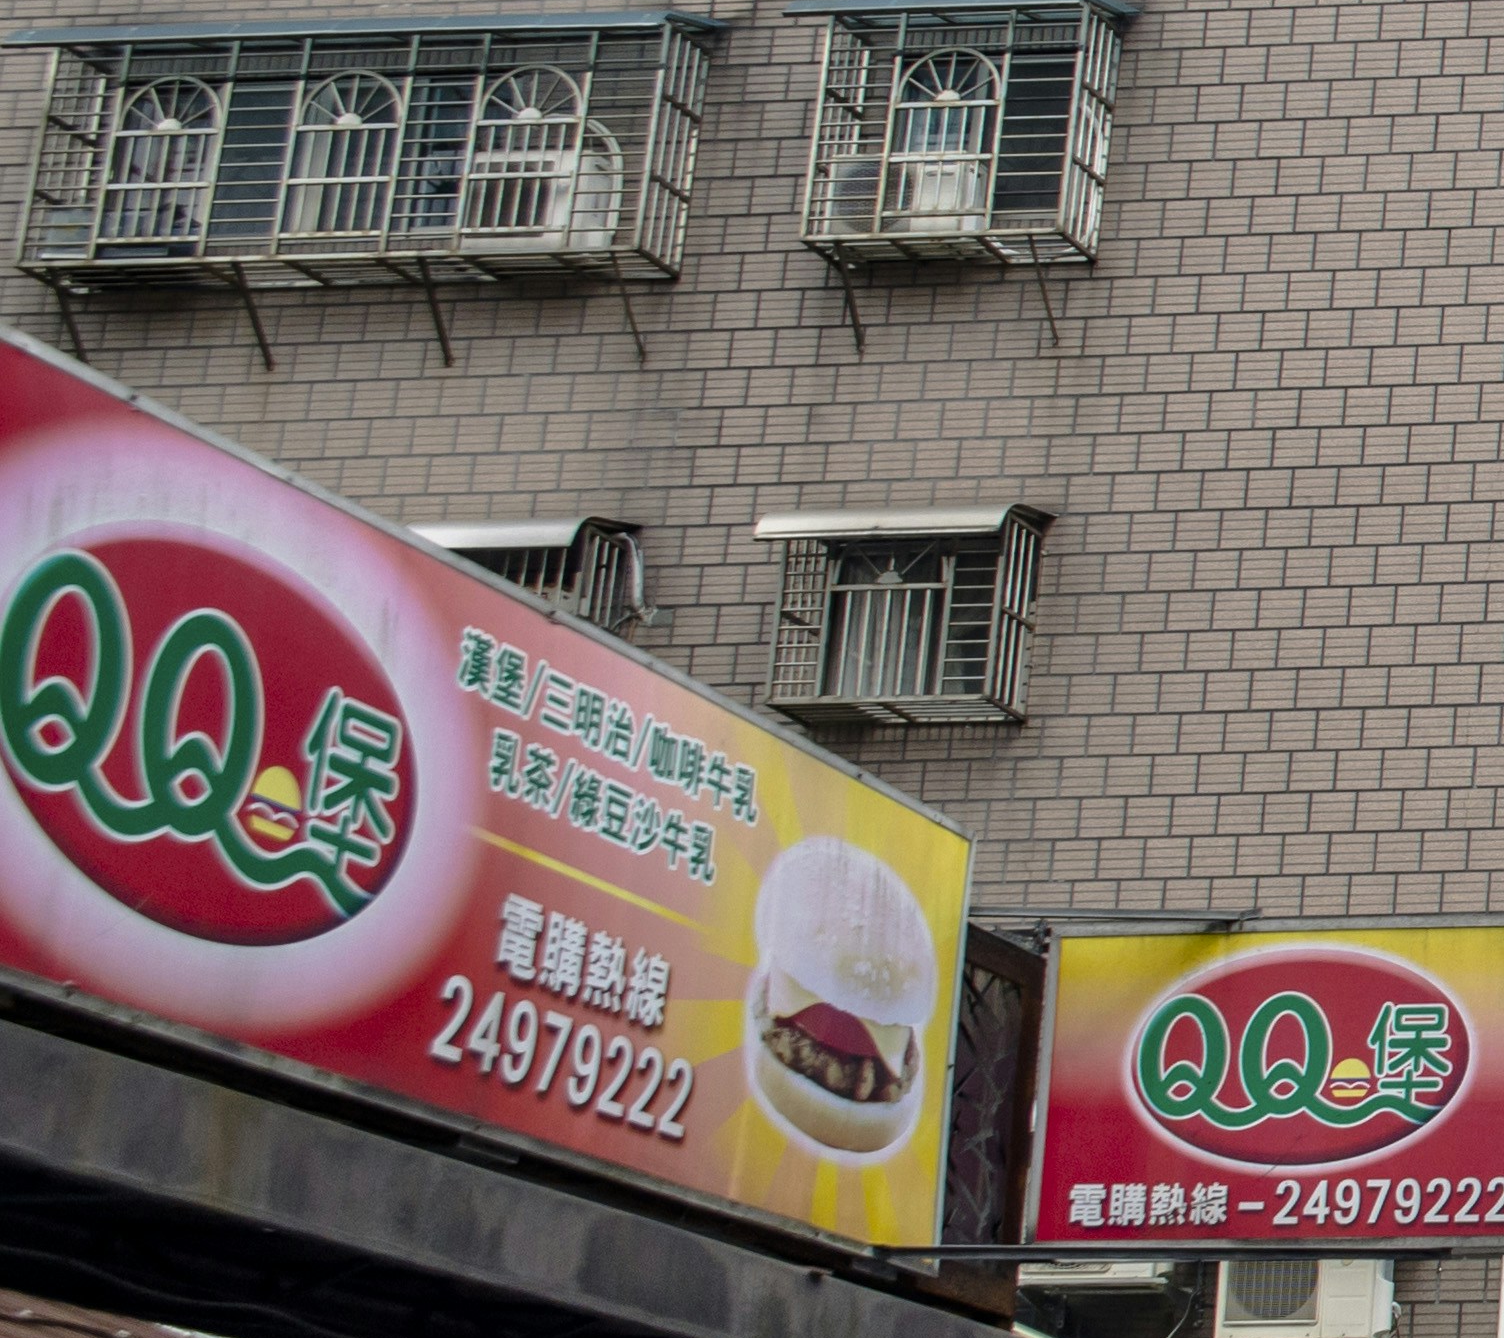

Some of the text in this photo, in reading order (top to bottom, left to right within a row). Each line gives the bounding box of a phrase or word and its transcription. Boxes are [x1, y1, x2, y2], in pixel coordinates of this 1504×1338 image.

[495, 893, 671, 1026] 電購熱線
[430, 975, 694, 1139] 24979222
[1138, 991, 1450, 1129] QQ堡
